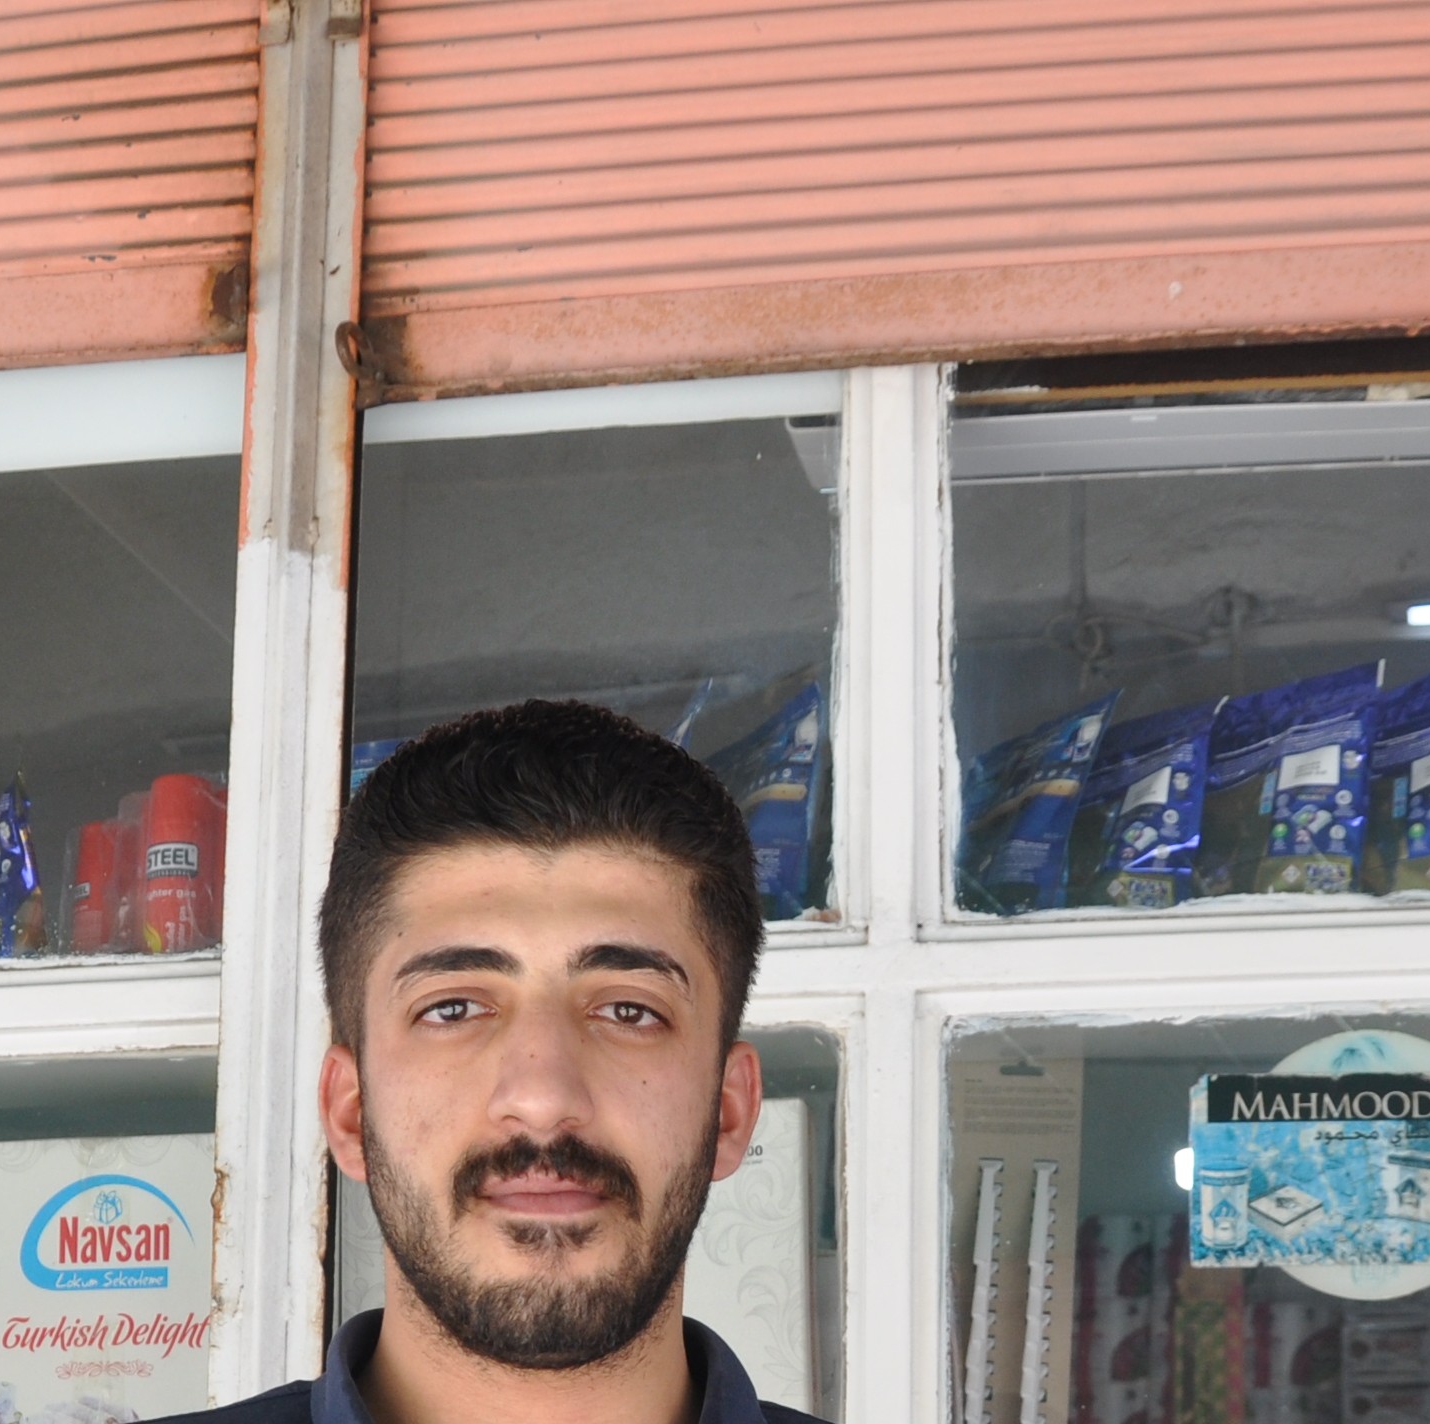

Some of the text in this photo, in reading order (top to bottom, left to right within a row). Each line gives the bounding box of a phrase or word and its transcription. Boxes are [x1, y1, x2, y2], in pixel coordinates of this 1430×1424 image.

[147, 848, 195, 869] STEEL
[59, 1216, 170, 1264] Navsan
[55, 1271, 99, 1288] Lokum
[2, 1312, 212, 1359] Turkish Delight
